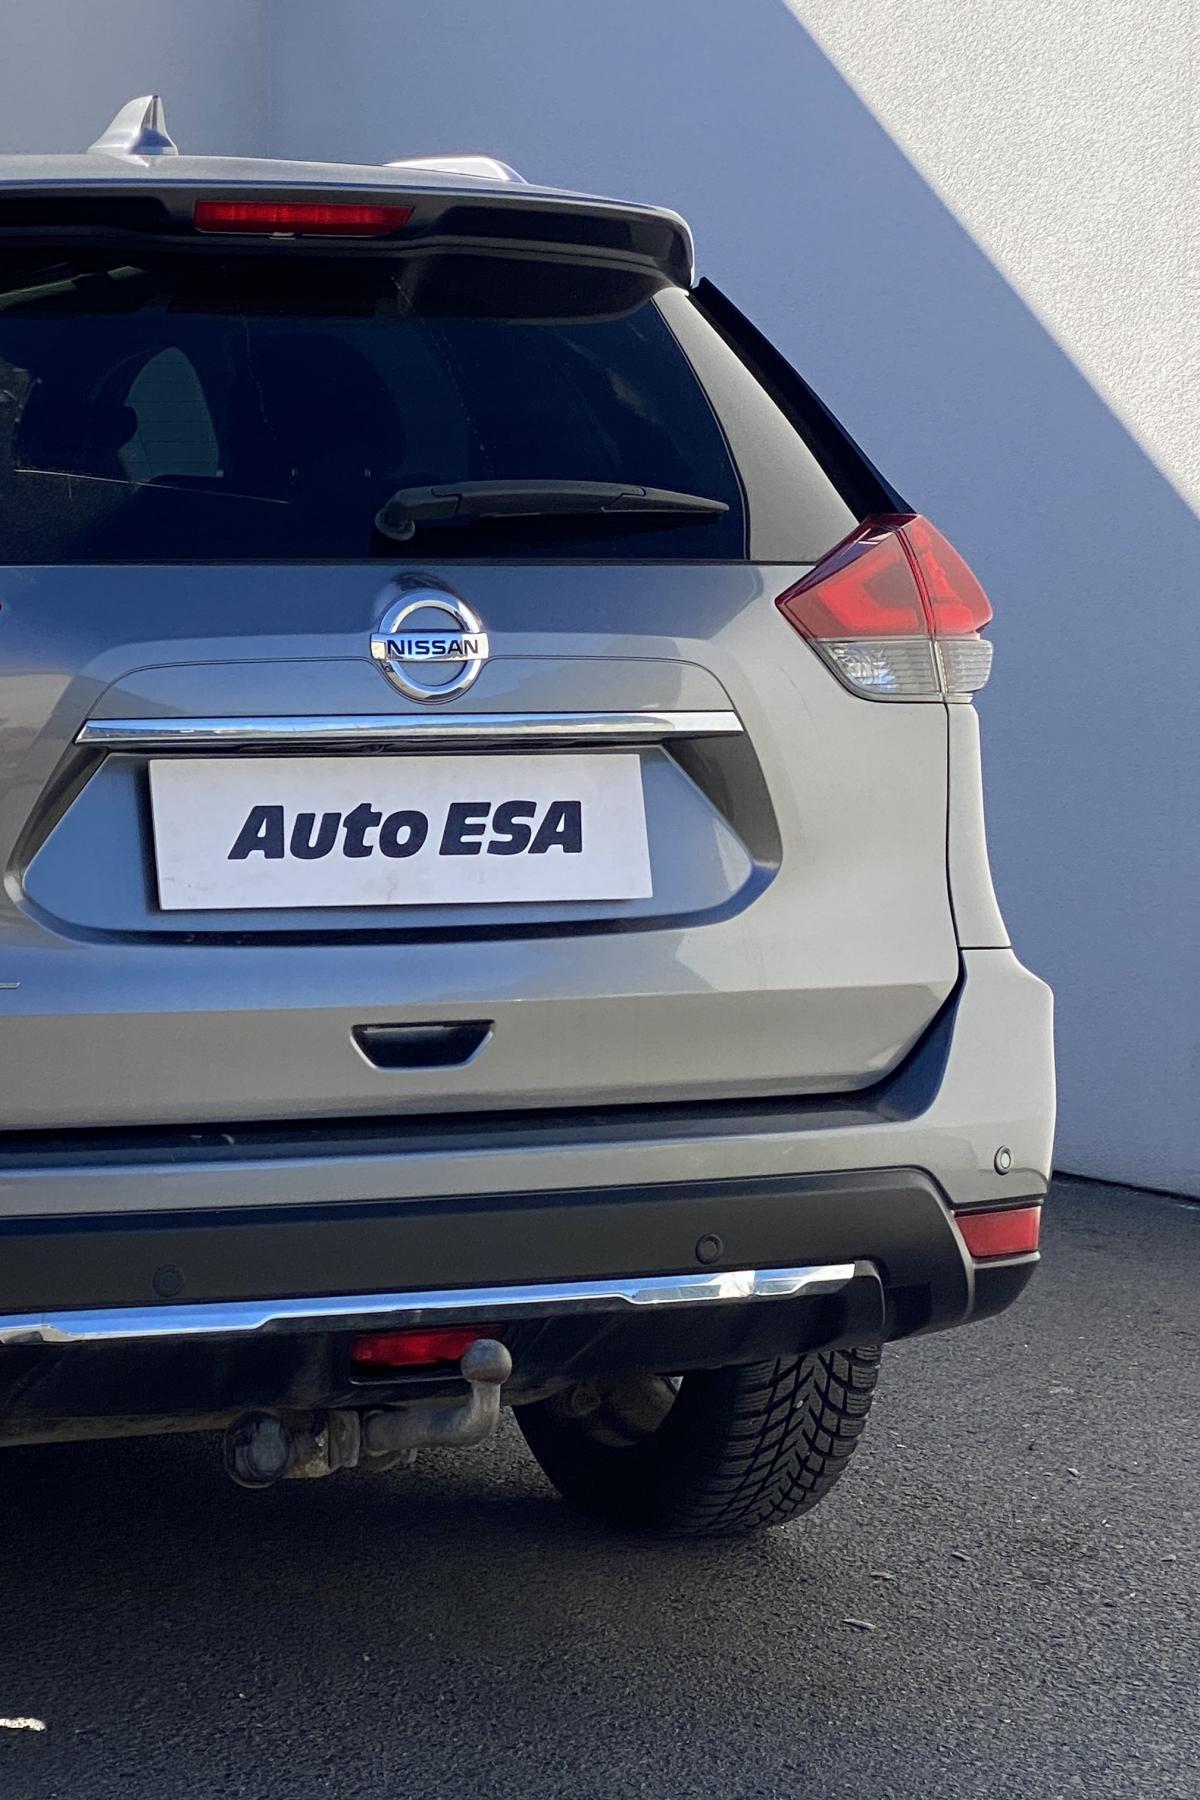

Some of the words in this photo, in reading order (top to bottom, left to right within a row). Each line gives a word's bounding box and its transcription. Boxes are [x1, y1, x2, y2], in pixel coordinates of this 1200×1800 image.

[386, 639, 479, 655] NISSAN
[227, 803, 429, 860] Auto
[438, 800, 583, 856] ESA
